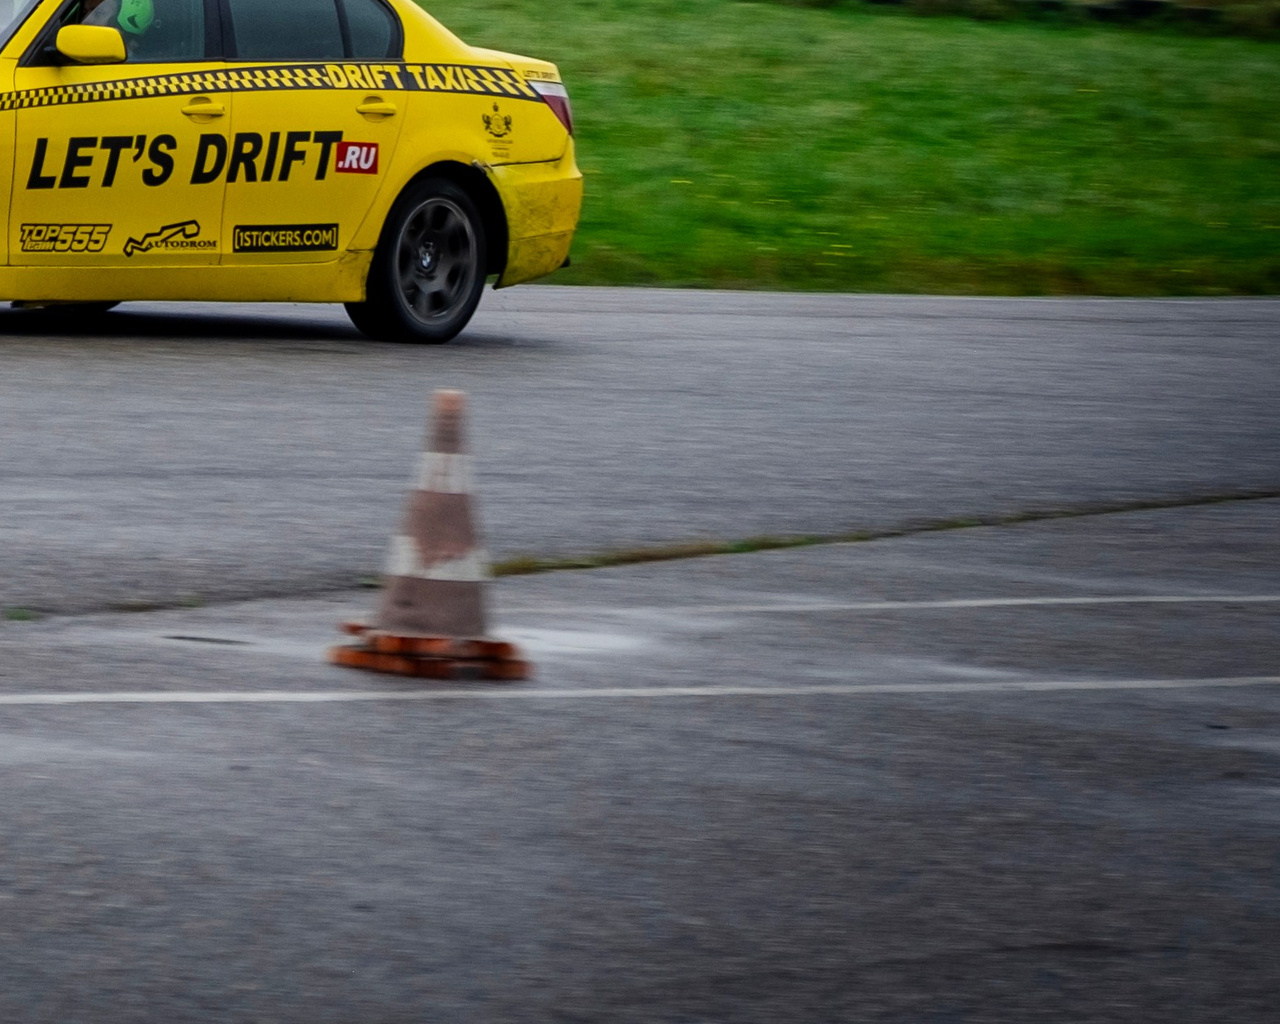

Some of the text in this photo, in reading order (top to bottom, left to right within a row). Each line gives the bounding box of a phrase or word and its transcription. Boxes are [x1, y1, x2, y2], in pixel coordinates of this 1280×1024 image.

[325, 65, 468, 91] DRIFT TAXI
[26, 134, 177, 189] LET'S
[190, 131, 343, 184] DRIFT
[55, 224, 112, 251] 555
[147, 240, 217, 249] AUTODROM
